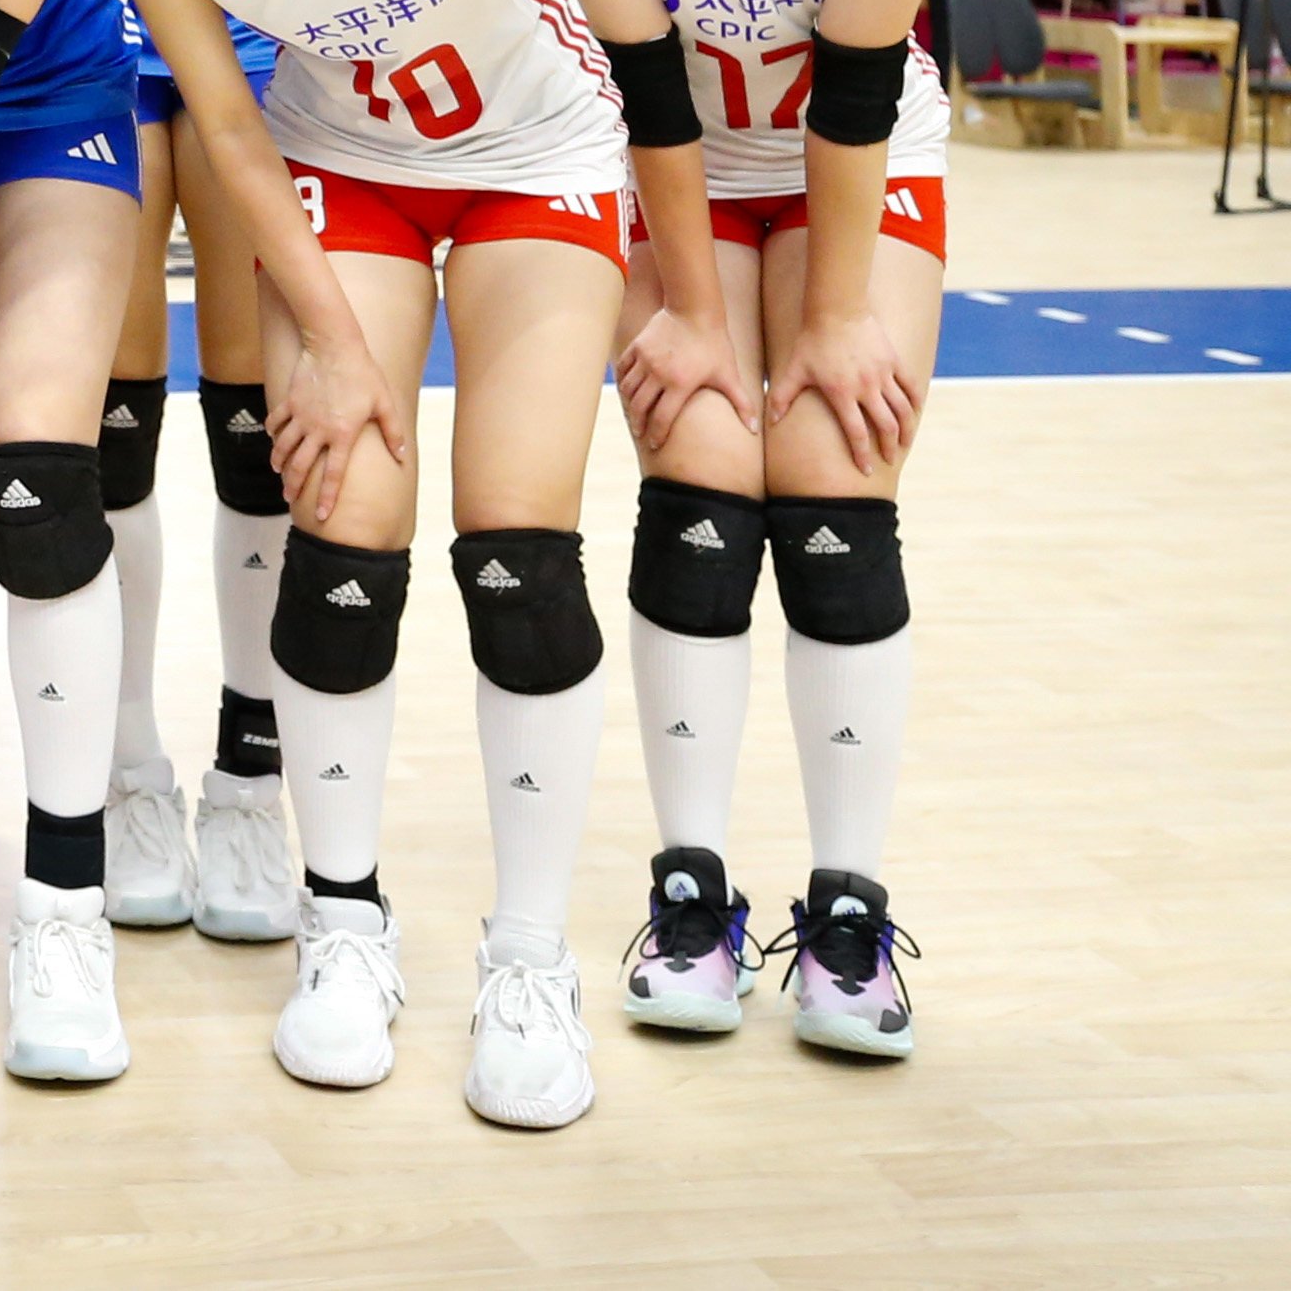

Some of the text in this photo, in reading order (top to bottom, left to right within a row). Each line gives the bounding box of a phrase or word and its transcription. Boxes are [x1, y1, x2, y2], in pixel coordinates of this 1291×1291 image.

[695, 17, 778, 43] CPIC
[318, 37, 399, 61] CPIC
[694, 38, 816, 130] 17
[0, 495, 43, 509] adidas
[476, 576, 521, 589] adidas
